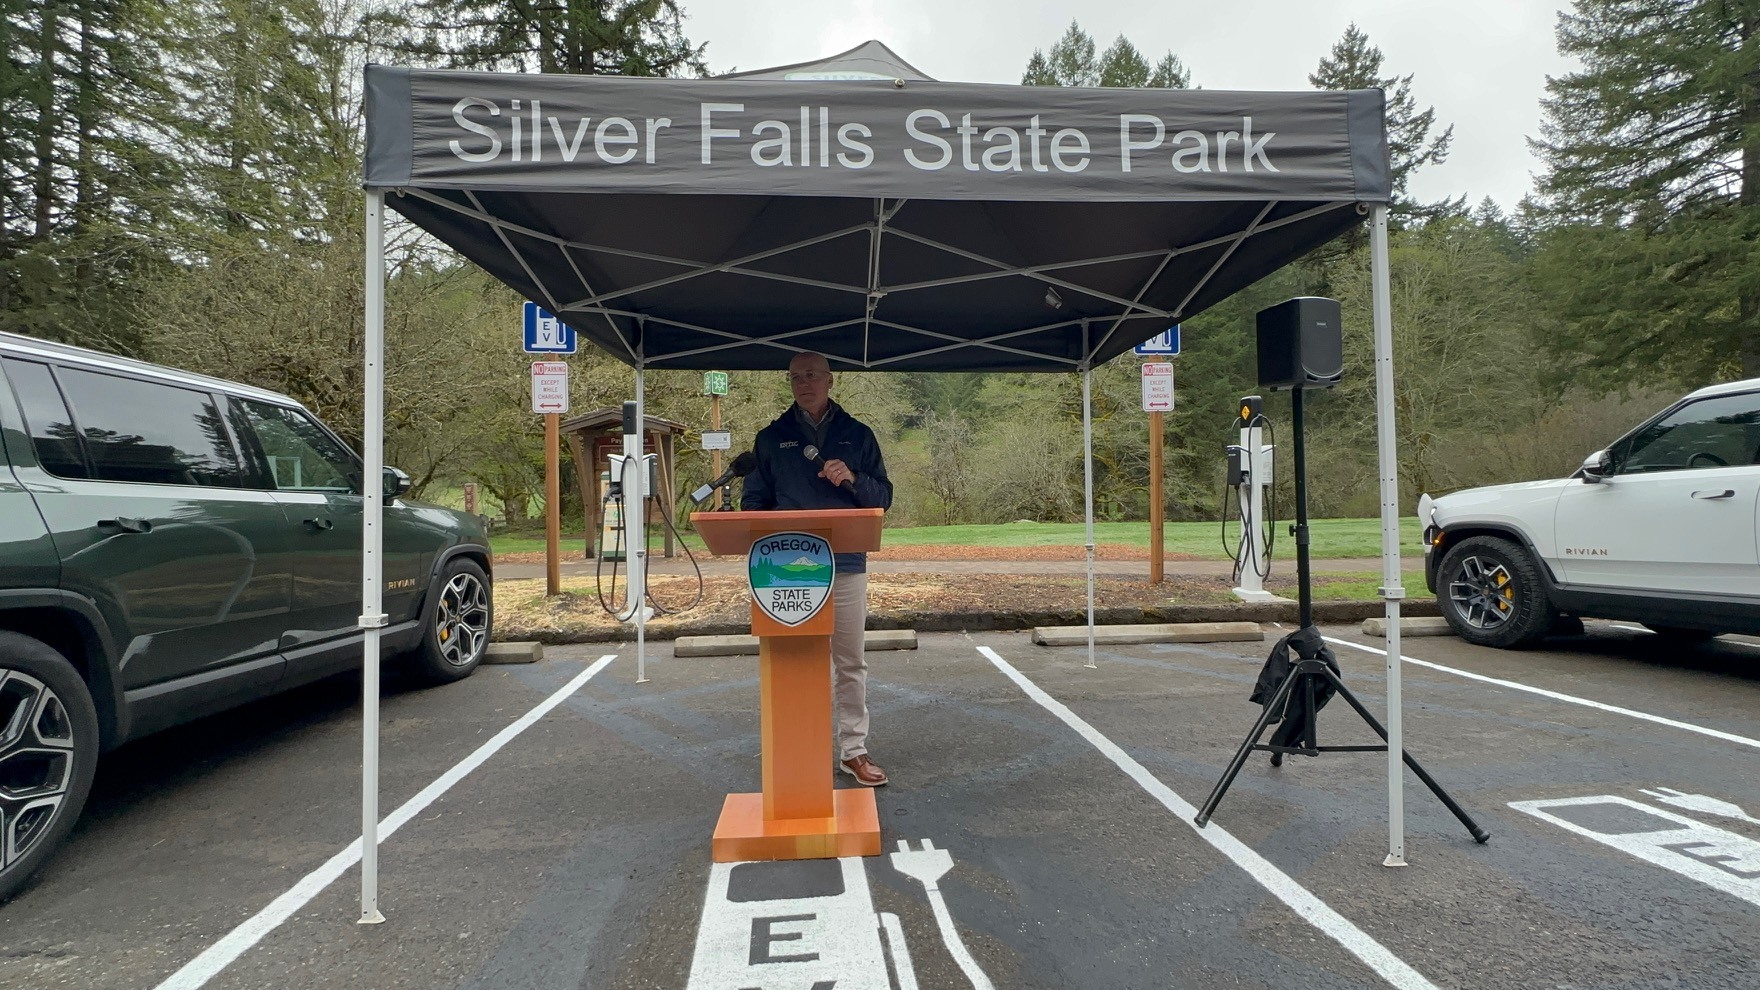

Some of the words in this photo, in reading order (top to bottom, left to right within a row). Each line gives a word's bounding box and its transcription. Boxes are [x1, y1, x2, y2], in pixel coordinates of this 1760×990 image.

[449, 97, 671, 164] Silver
[700, 102, 875, 169] Falls
[904, 108, 1091, 172] State
[1120, 114, 1280, 174] Park
[534, 364, 544, 375] NO
[545, 365, 566, 373] PARKING
[760, 539, 821, 555] OREGON
[1566, 548, 1608, 556] RIVIAN
[388, 578, 416, 590] RIVIAN
[772, 589, 810, 600] STATE
[772, 601, 812, 612] PARKS
